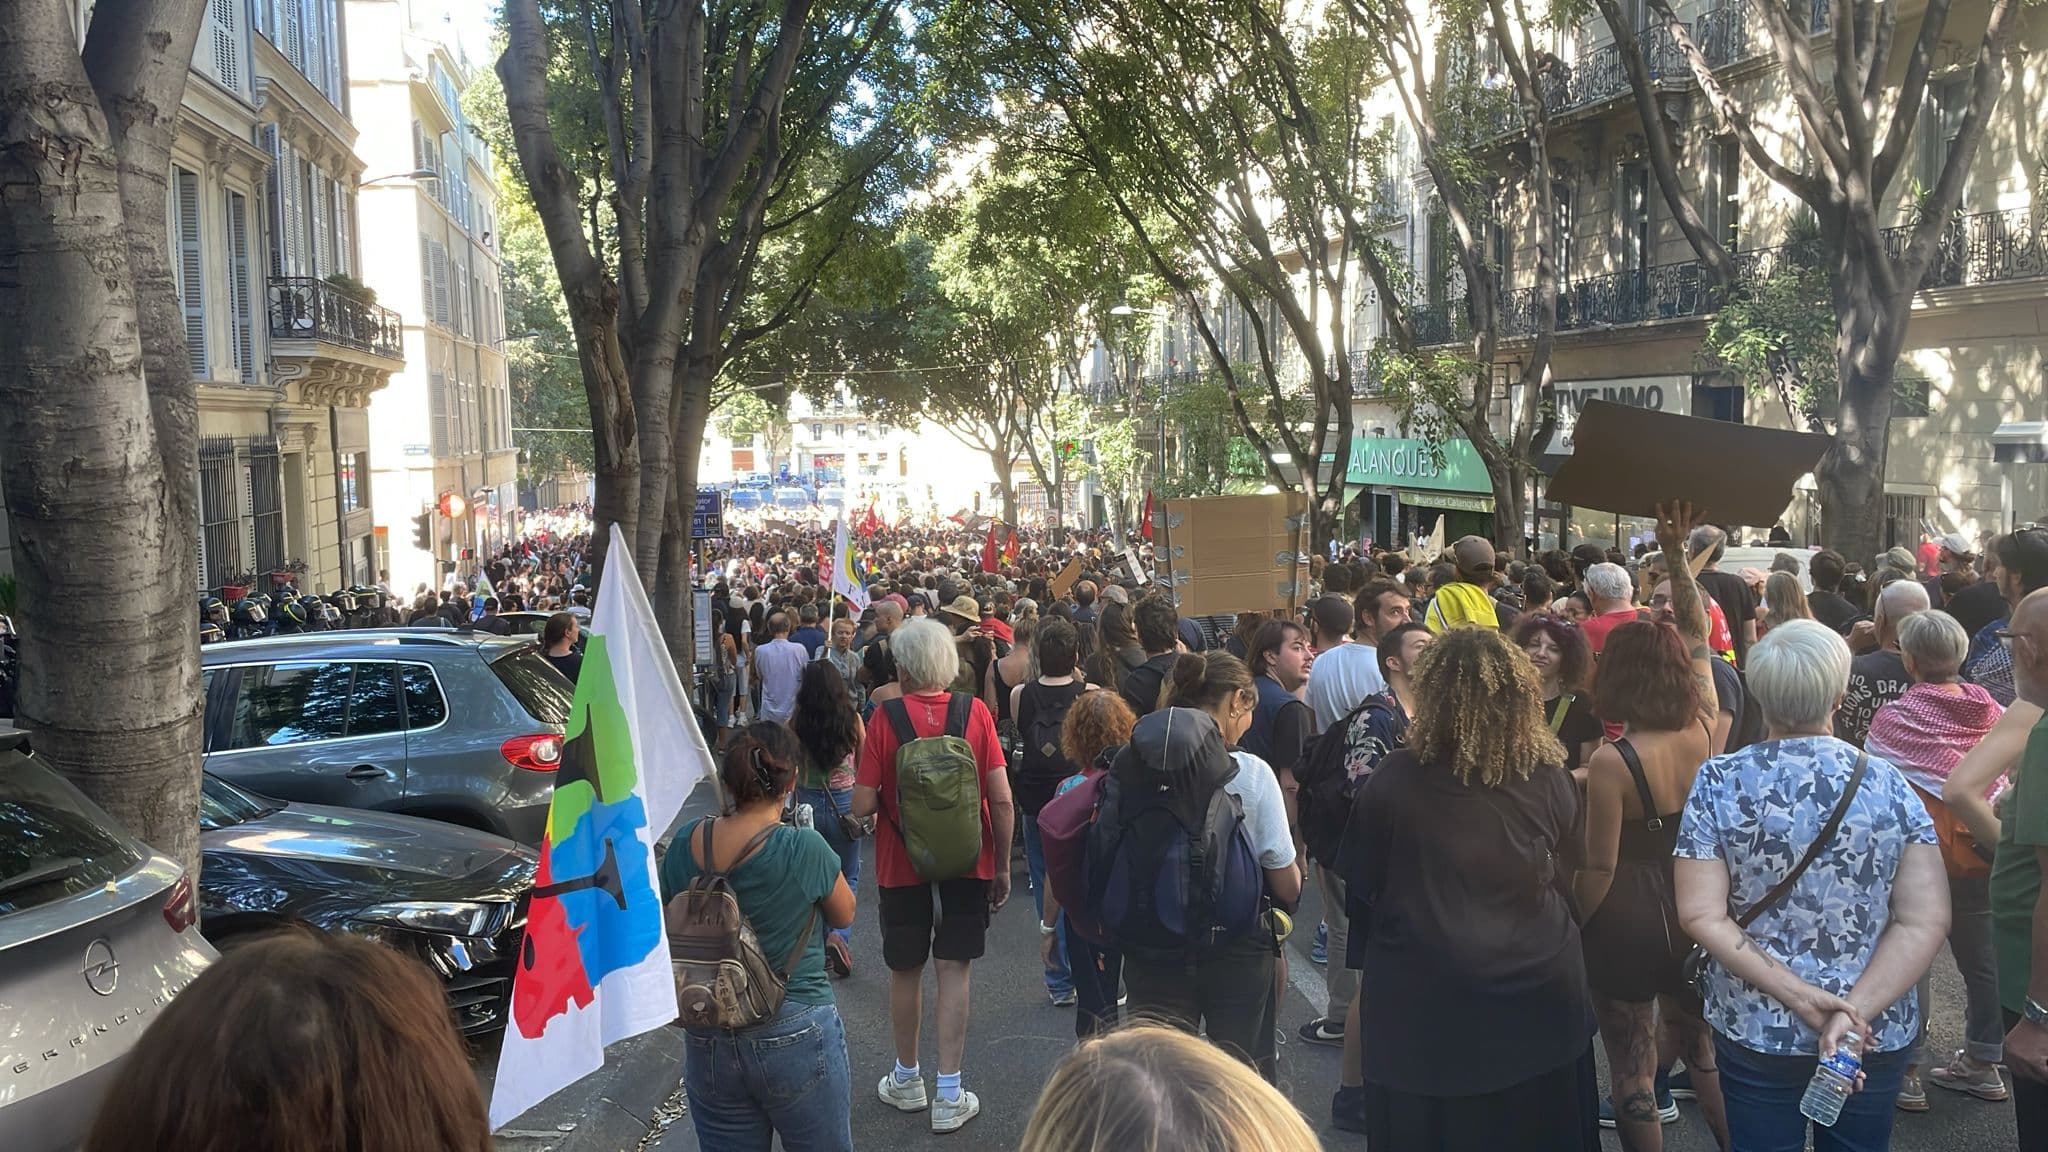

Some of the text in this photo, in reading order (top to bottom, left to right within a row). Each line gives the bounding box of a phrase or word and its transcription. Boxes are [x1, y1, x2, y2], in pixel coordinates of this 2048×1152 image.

[1602, 385, 1664, 411] IMMO
[1347, 448, 1440, 478] ALANQUES
[1447, 497, 1483, 511] Calanque
[707, 517, 717, 525] N1
[1876, 679, 1909, 694] DRA
